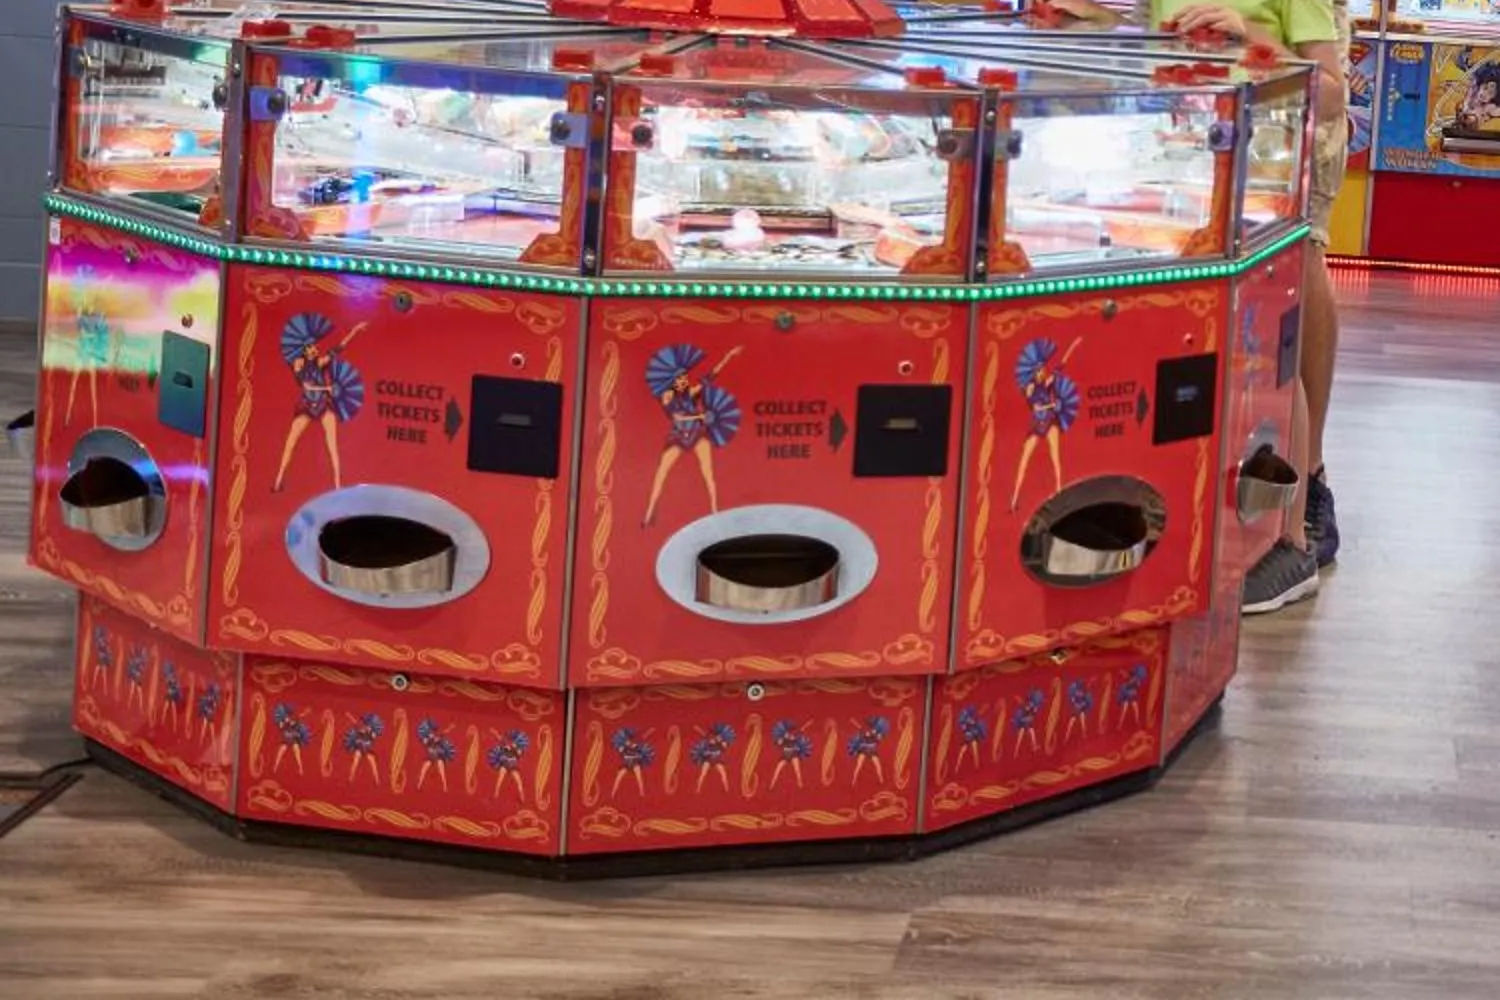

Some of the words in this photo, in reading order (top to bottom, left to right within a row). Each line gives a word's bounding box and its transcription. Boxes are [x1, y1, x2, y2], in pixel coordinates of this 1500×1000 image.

[376, 380, 444, 400] COLLECT
[1088, 381, 1137, 399] COLLECT
[378, 402, 440, 423] TICKETS
[753, 399, 827, 415] COLLECT
[1089, 401, 1133, 419] TICKETS
[387, 426, 427, 444] HERE
[756, 421, 823, 438] TICKETS
[1095, 423, 1124, 438] HERE
[768, 443, 811, 459] HERE
